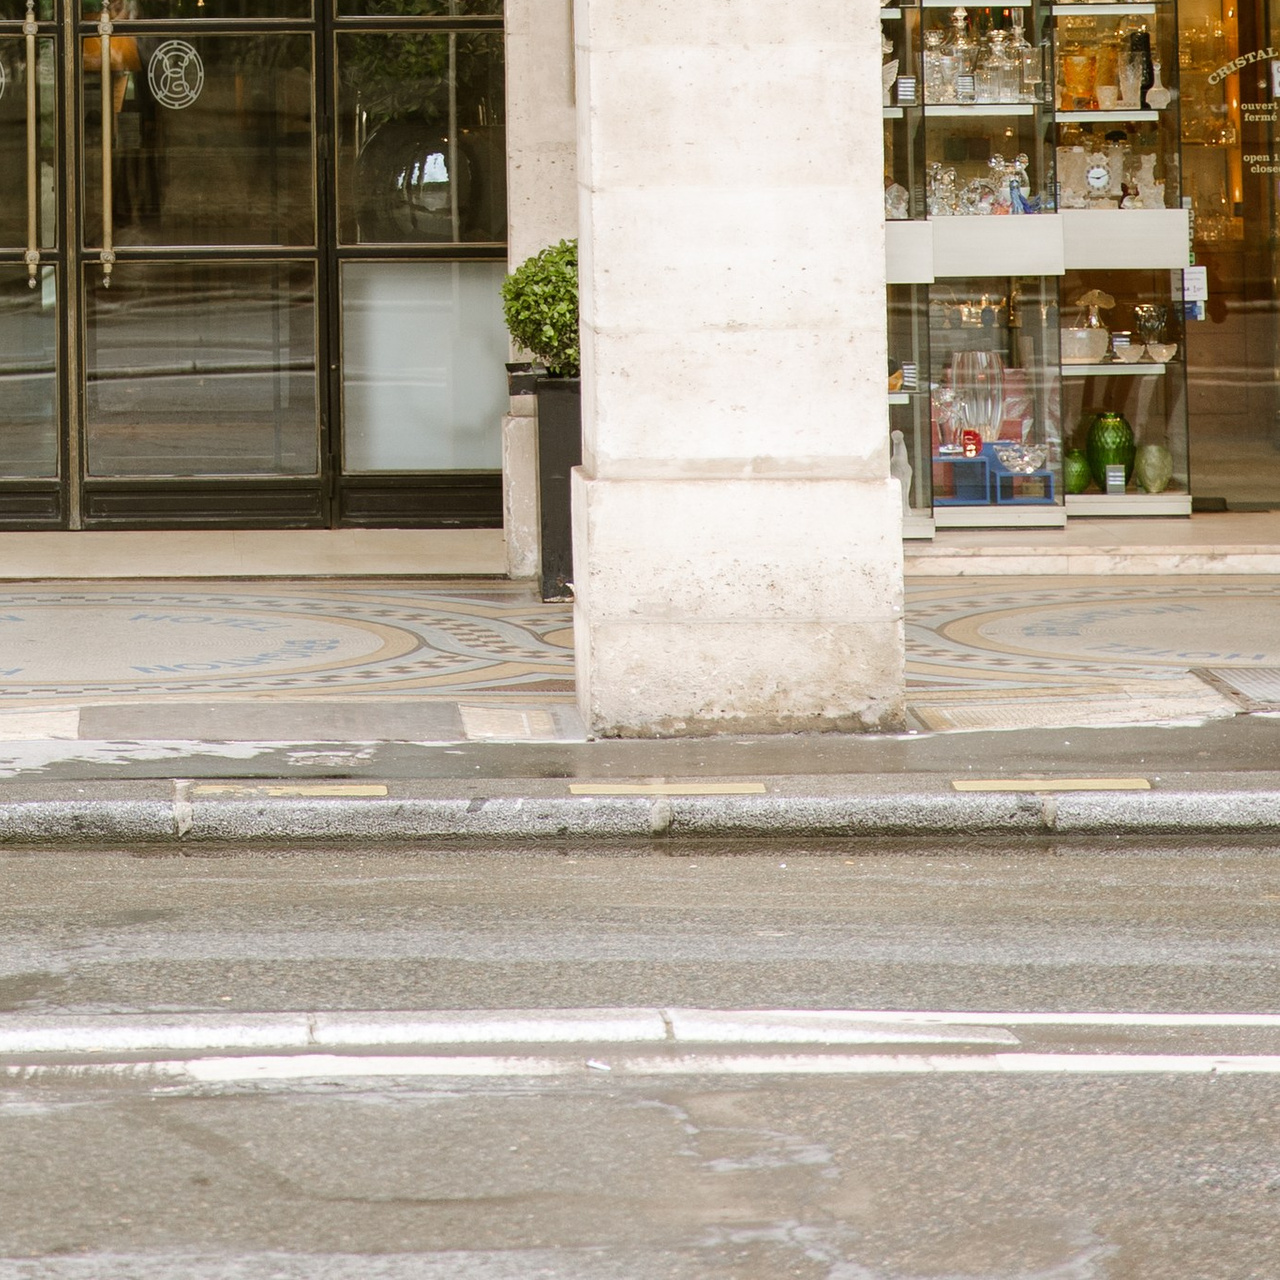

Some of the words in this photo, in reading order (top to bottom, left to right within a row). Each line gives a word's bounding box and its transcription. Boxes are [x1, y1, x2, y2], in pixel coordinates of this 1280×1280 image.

[1208, 47, 1279, 85] CRISTAL
[1240, 101, 1279, 111] ouvert
[1244, 112, 1278, 122] fermé
[1243, 154, 1270, 164] open
[1250, 164, 1280, 174] close
